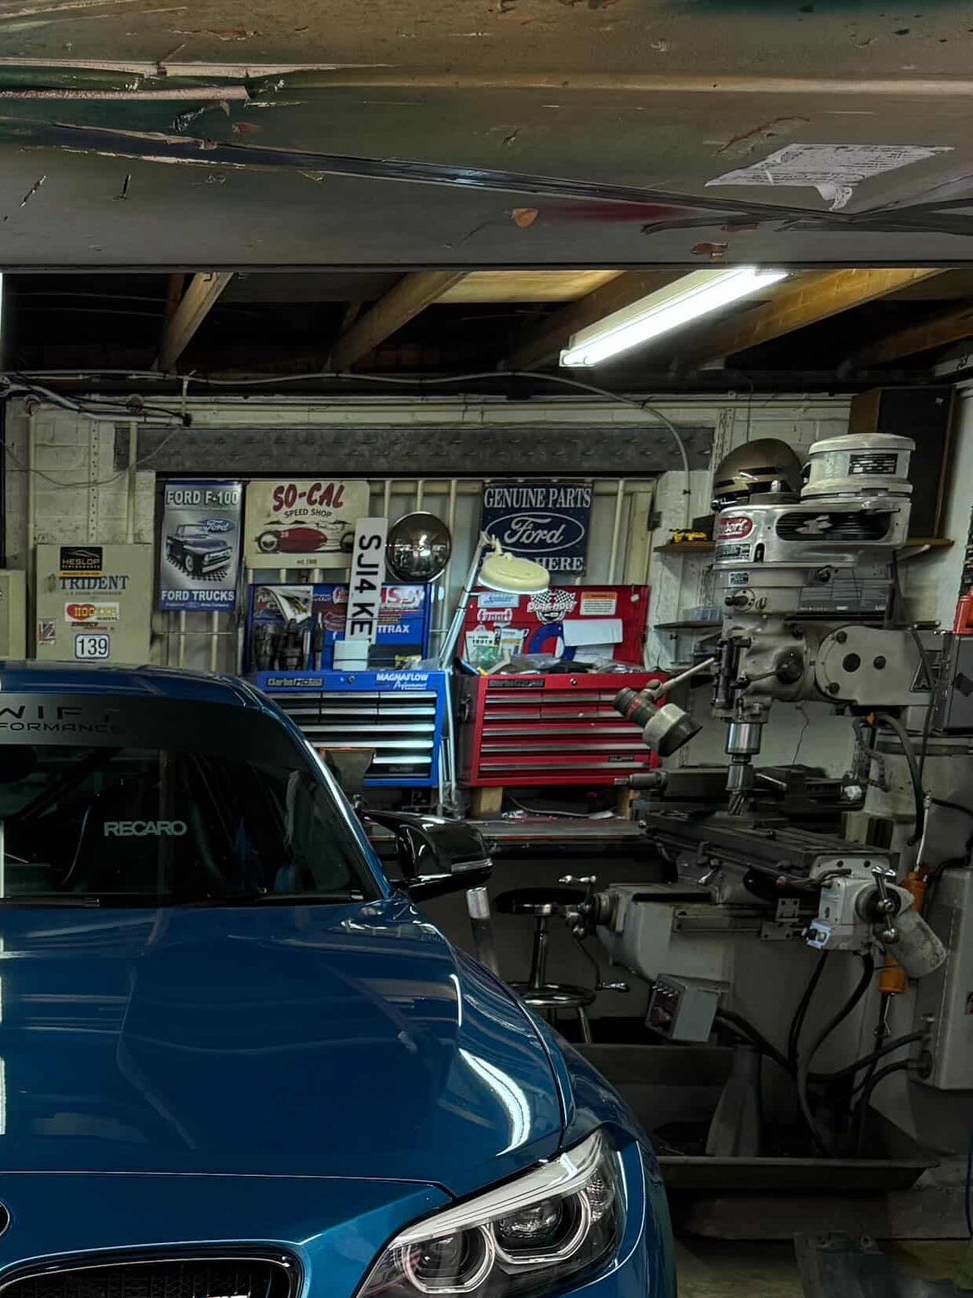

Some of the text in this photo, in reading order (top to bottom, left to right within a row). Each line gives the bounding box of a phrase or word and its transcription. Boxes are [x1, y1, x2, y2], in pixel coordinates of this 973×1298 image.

[166, 490, 201, 505] FORD
[273, 483, 345, 511] SO-CAL
[484, 488, 591, 509] GENUINE PARTS
[284, 508, 332, 518] SPEED SHOP
[203, 519, 229, 531] Ford
[504, 517, 566, 543] Ford
[60, 575, 129, 590] TRIDENT
[161, 590, 235, 601] FORD TRUCKS
[350, 603, 376, 643] KE
[78, 638, 107, 655] 139
[377, 672, 428, 681] MAGNAFLOW
[103, 820, 188, 837] RECARO
